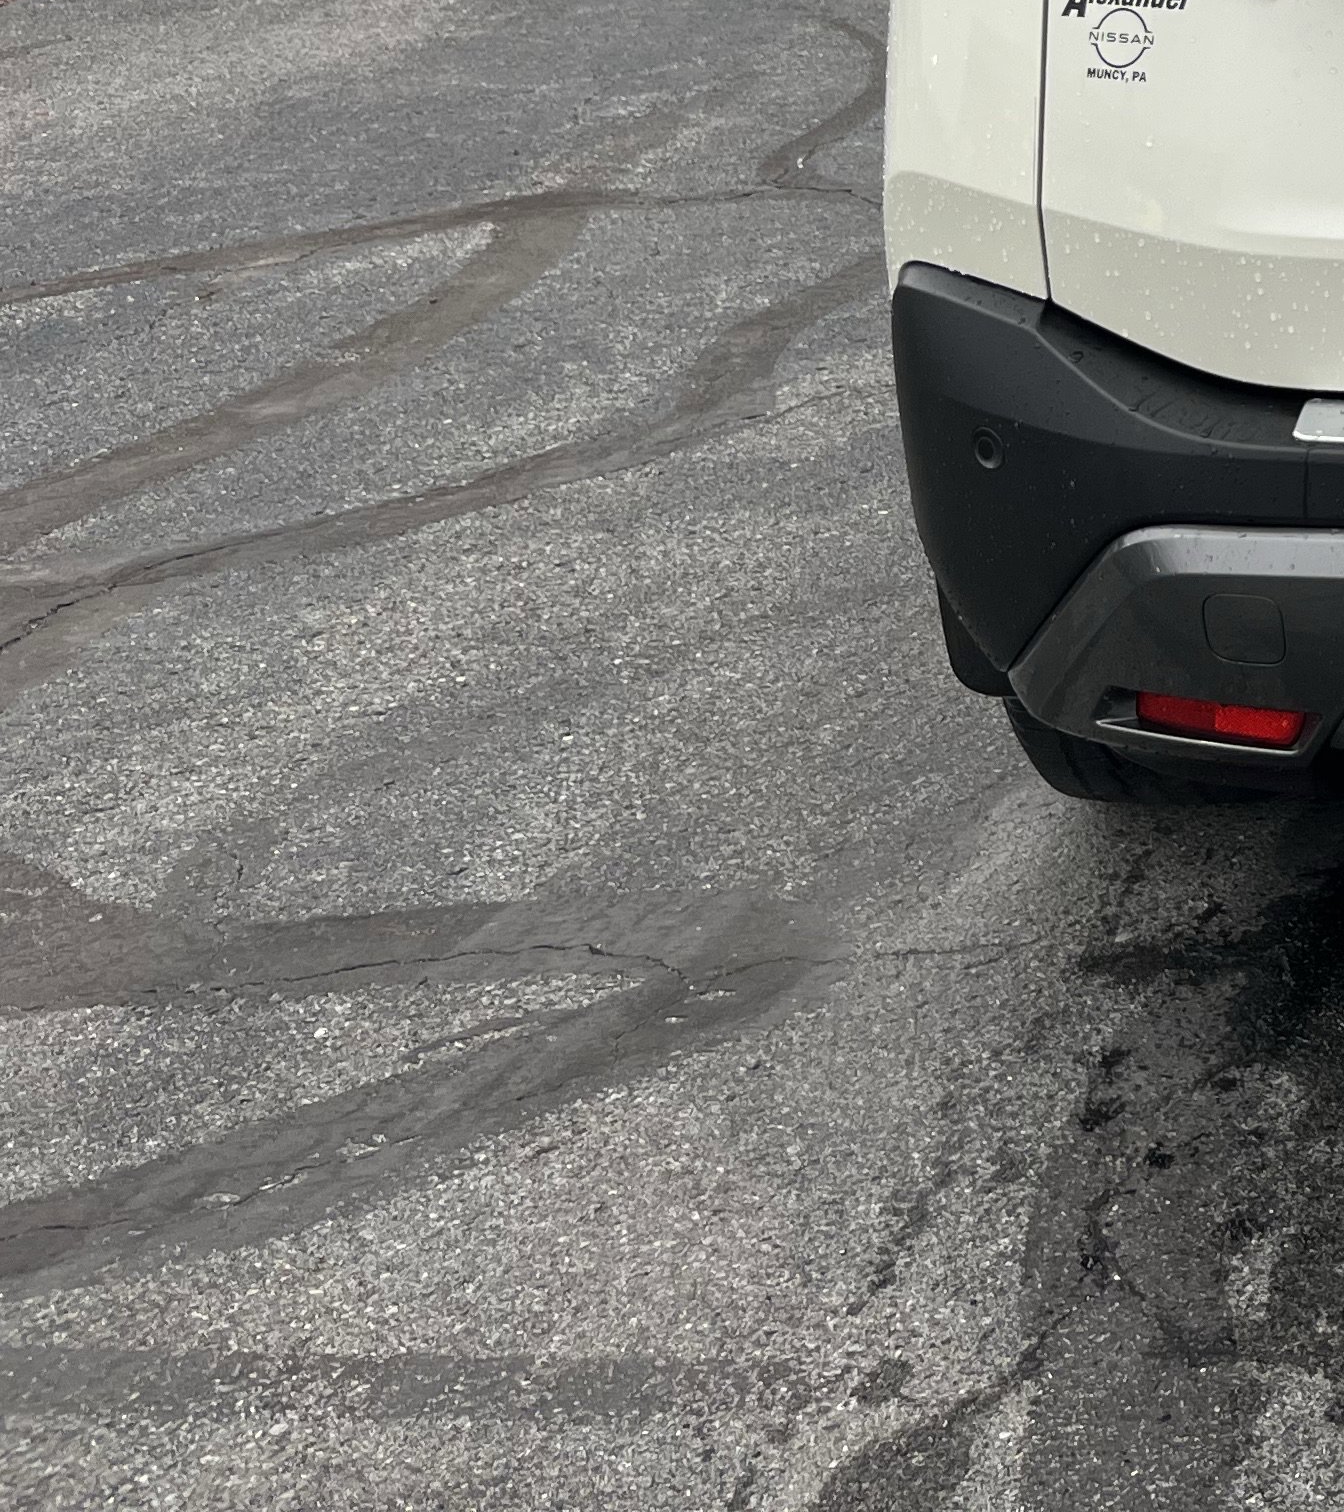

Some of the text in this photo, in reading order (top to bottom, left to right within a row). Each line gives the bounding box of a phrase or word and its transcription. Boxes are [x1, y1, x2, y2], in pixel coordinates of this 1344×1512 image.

[1088, 31, 1155, 46] NISSAN
[1087, 68, 1147, 84] MUNCY, PA
